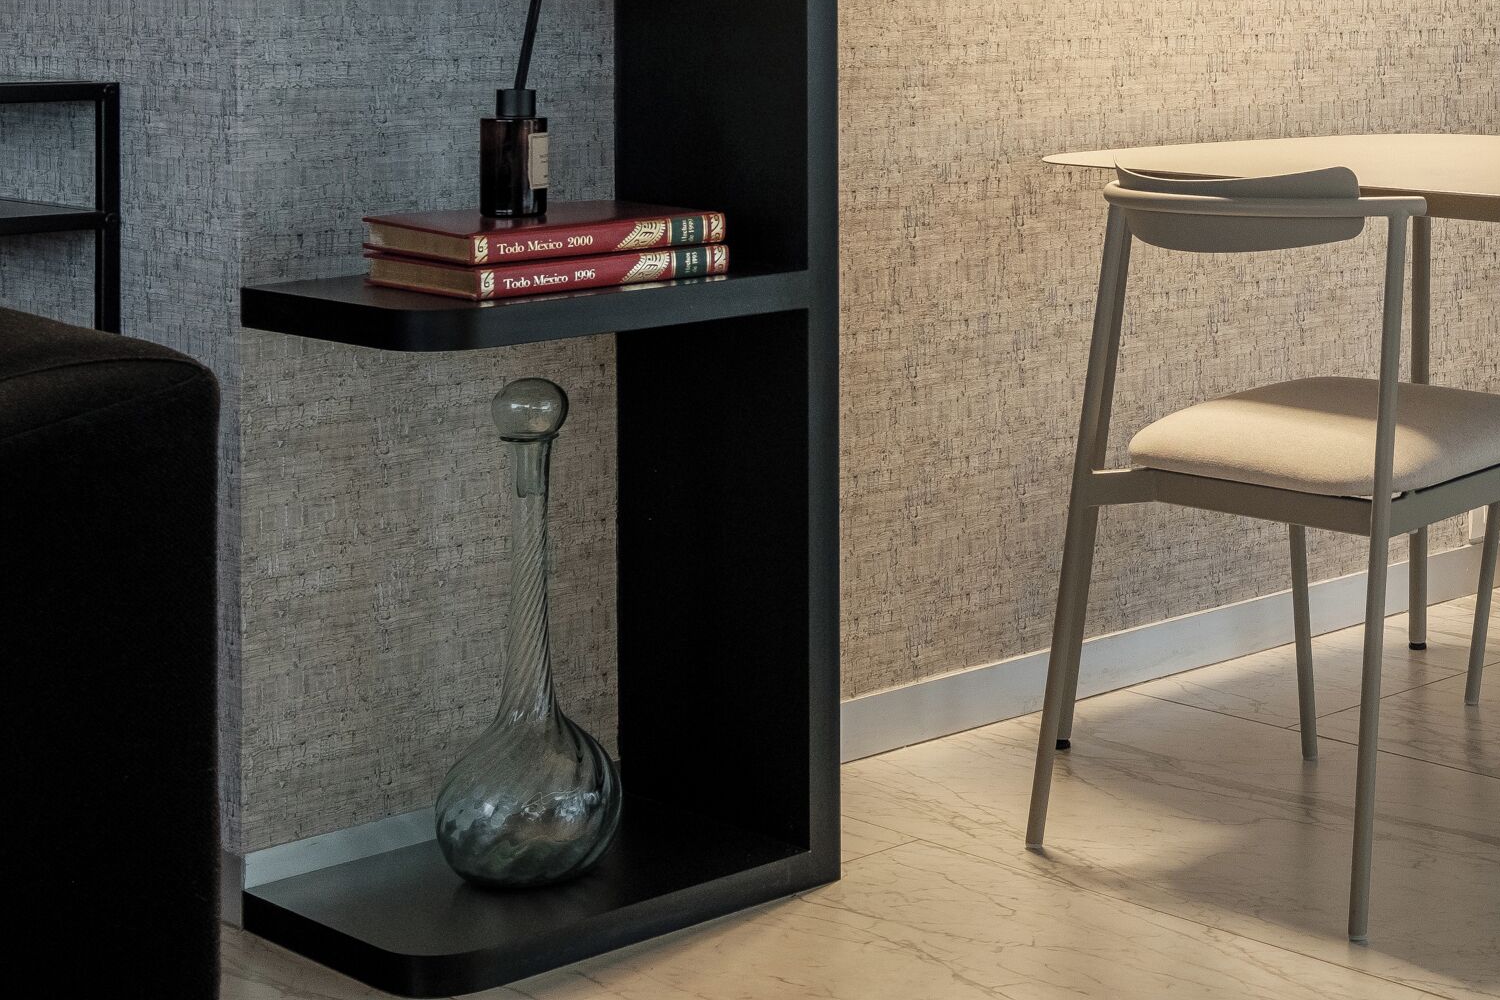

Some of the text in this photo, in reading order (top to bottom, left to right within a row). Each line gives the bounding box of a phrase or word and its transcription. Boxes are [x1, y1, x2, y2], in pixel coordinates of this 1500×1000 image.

[496, 235, 593, 255] Todo México 2000
[503, 268, 596, 290] Todo México 1996
